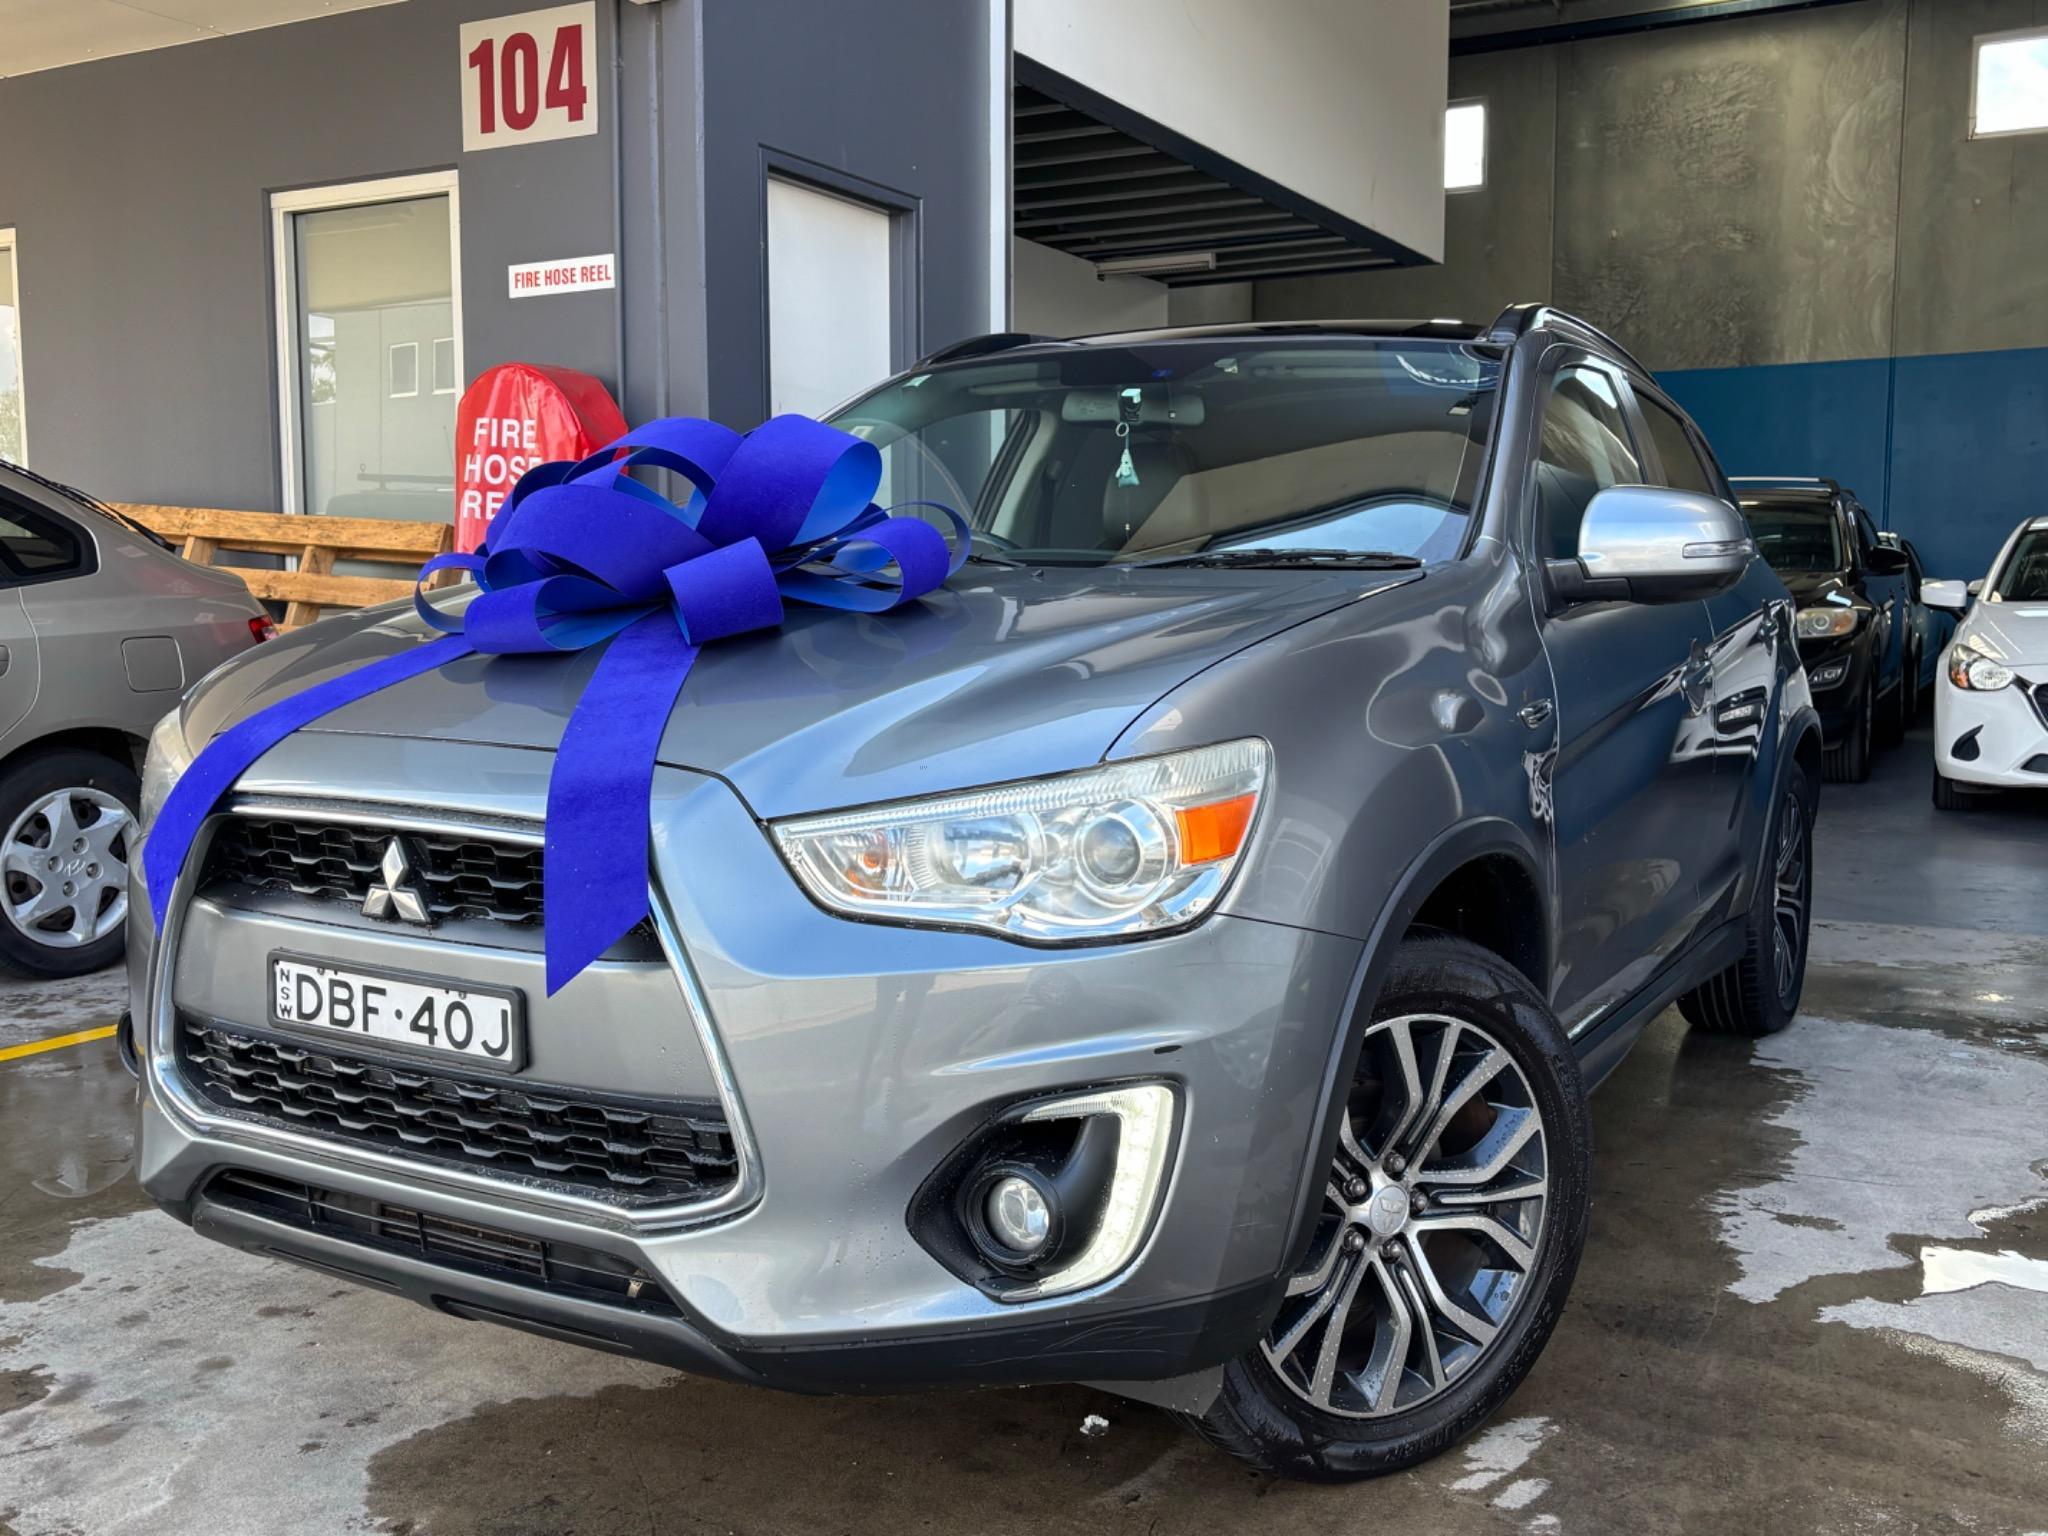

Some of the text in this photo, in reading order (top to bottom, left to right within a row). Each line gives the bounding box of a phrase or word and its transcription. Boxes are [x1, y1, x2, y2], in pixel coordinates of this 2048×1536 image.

[469, 24, 587, 134] 104
[514, 264, 612, 289] FIRE HOSE REEL
[473, 417, 537, 449] FIRE
[462, 490, 504, 520] RE
[280, 967, 293, 1019] NSW
